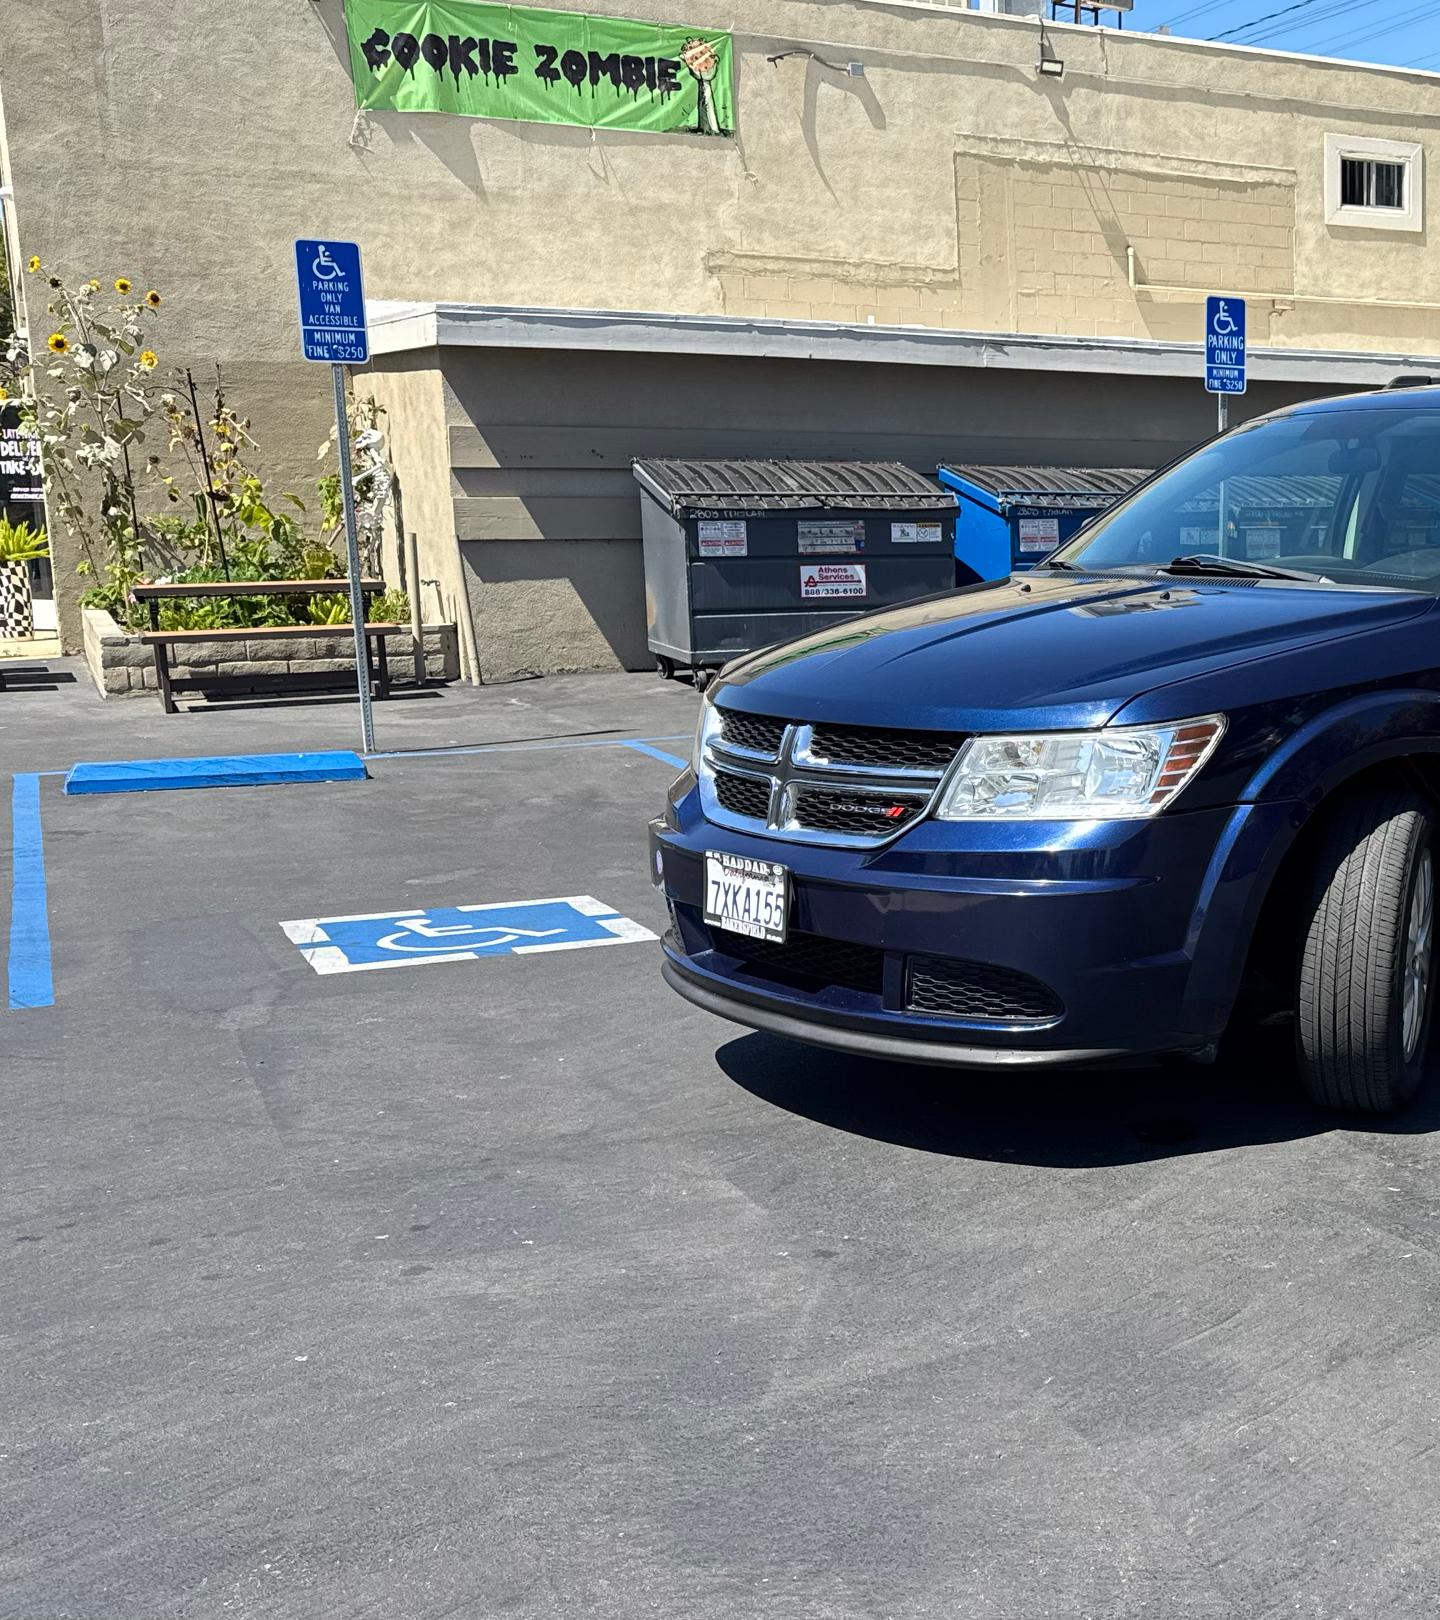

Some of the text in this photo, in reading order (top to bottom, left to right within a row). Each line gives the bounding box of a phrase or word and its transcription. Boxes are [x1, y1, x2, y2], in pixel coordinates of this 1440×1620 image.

[360, 27, 682, 105] COOKIE ZOMBIE
[312, 281, 350, 292] PARKING
[320, 293, 342, 303] ONLY
[323, 304, 341, 314] VAN
[308, 314, 359, 326] ACCESSIBLE
[313, 331, 356, 344] MINIMUM
[1208, 334, 1244, 350] PARKING
[308, 345, 364, 358] FINE $250
[1215, 350, 1237, 364] ONLY
[1212, 368, 1239, 379] MINIMUM
[1208, 379, 1243, 390] FINE $250
[818, 566, 848, 574] Athens
[818, 573, 855, 581] Services
[804, 588, 863, 596] 888/336-6100
[829, 803, 889, 815] DODGE
[711, 880, 785, 928] 7XKA155
